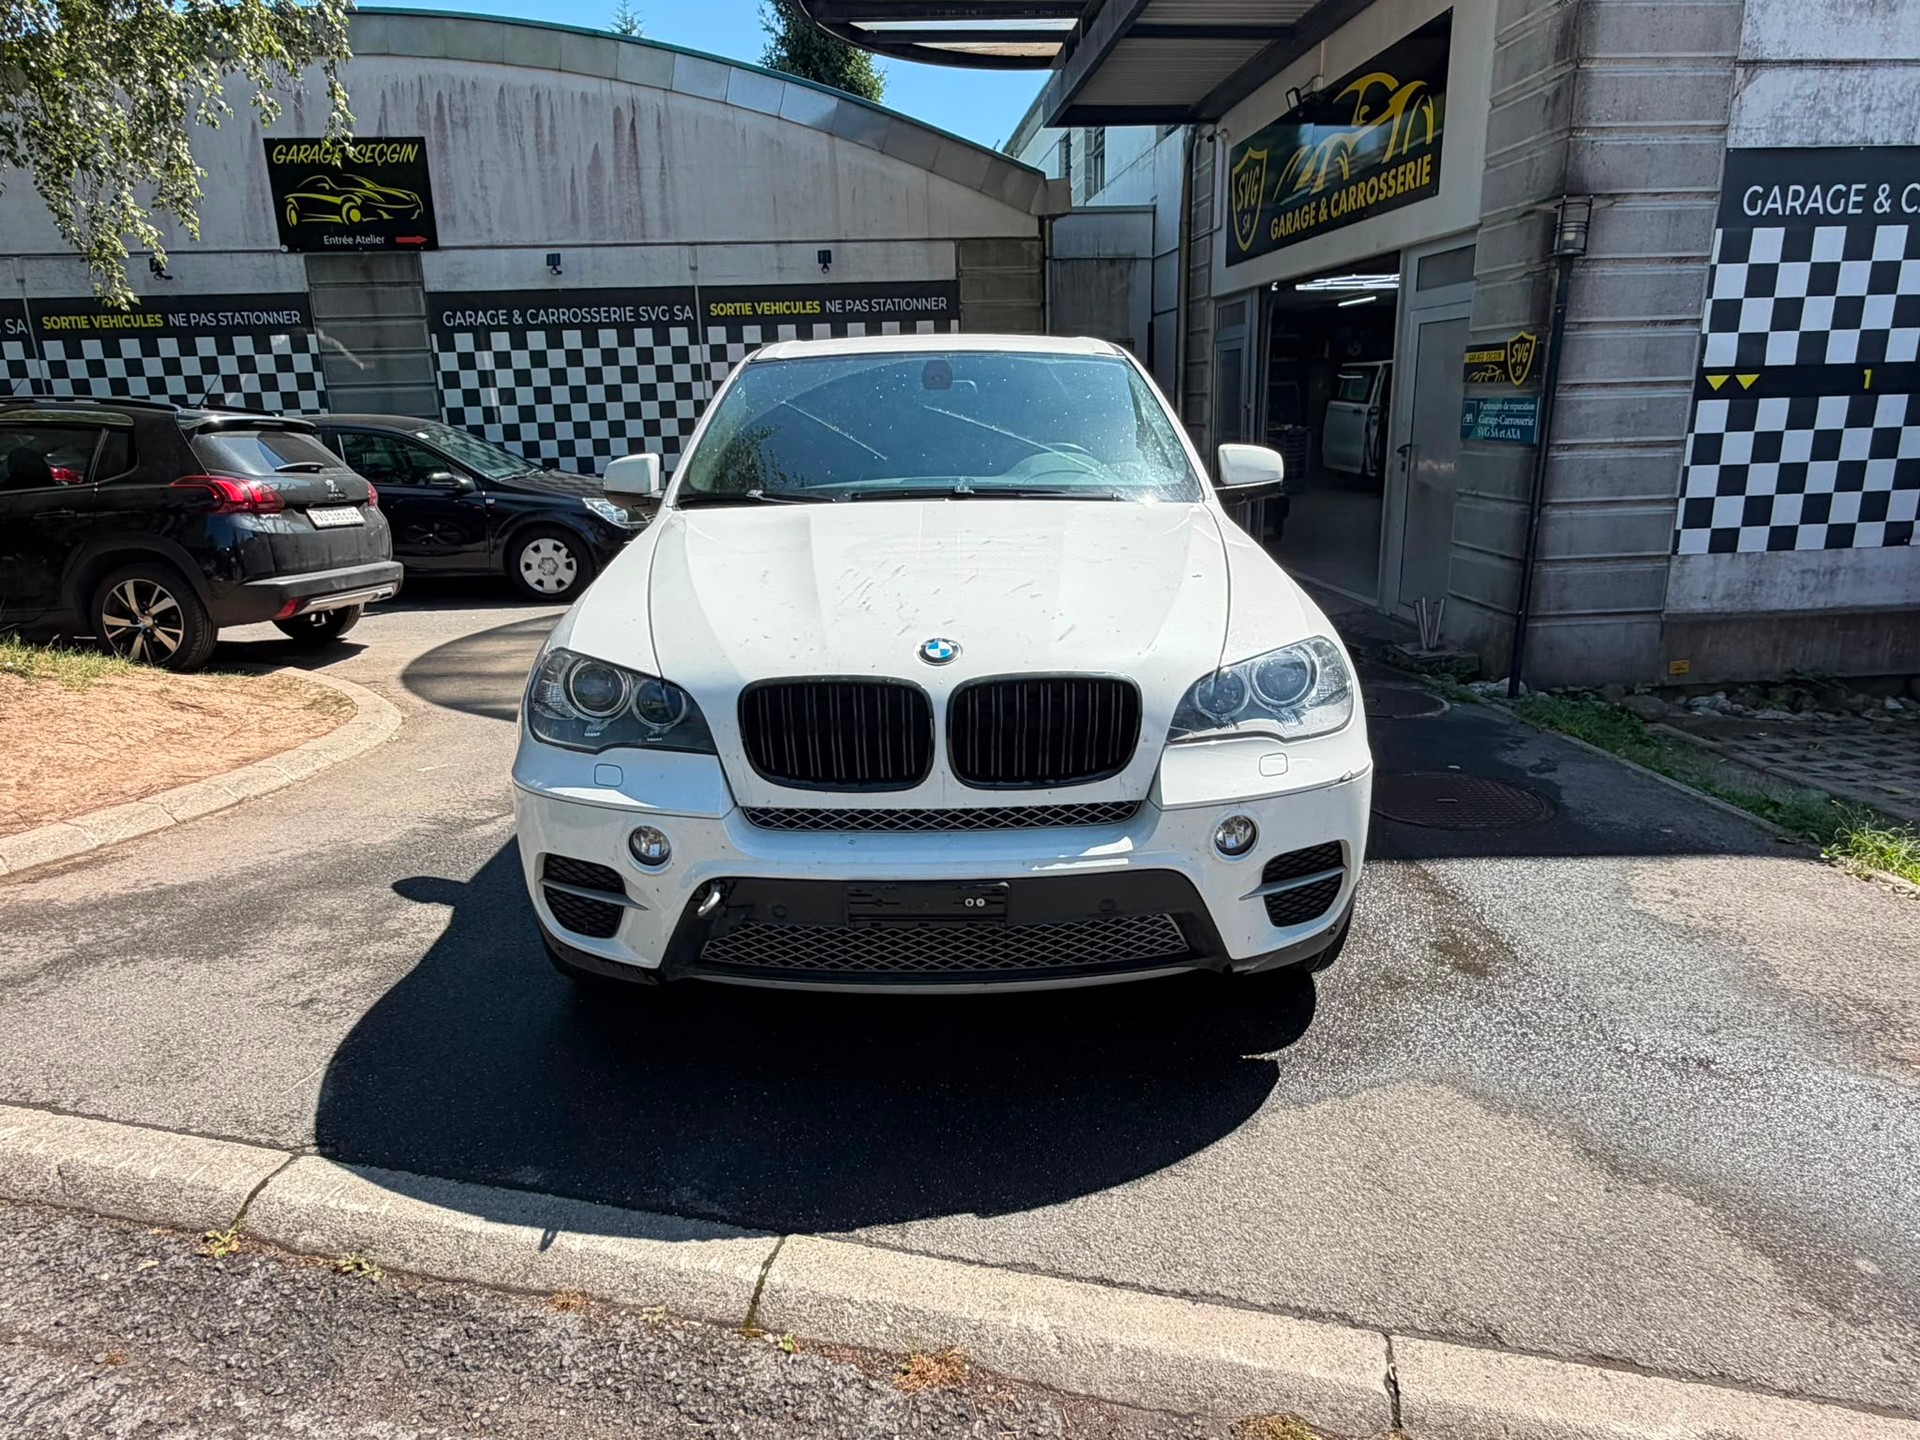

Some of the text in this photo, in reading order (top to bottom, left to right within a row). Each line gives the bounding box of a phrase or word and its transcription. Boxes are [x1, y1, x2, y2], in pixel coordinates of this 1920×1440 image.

[349, 143, 418, 166] SEÇGIN
[1237, 166, 1259, 212] SVG
[1270, 154, 1432, 240] GARAGE & CARROSSERIE
[1742, 183, 1920, 216] GARAGE & C
[1242, 214, 1250, 235] SA
[323, 234, 385, 245] Entrée Atelier
[442, 305, 694, 326] GARAGE & CARROSSERIE SVG SA
[709, 297, 948, 316] SORTIE VEHICULES NE PAS STATIONNER
[4, 319, 29, 335] SA
[41, 311, 302, 329] SORTIE VEHICULES NE PAS STATIONNER
[1511, 342, 1530, 363] SVG
[1863, 369, 1872, 389] 1
